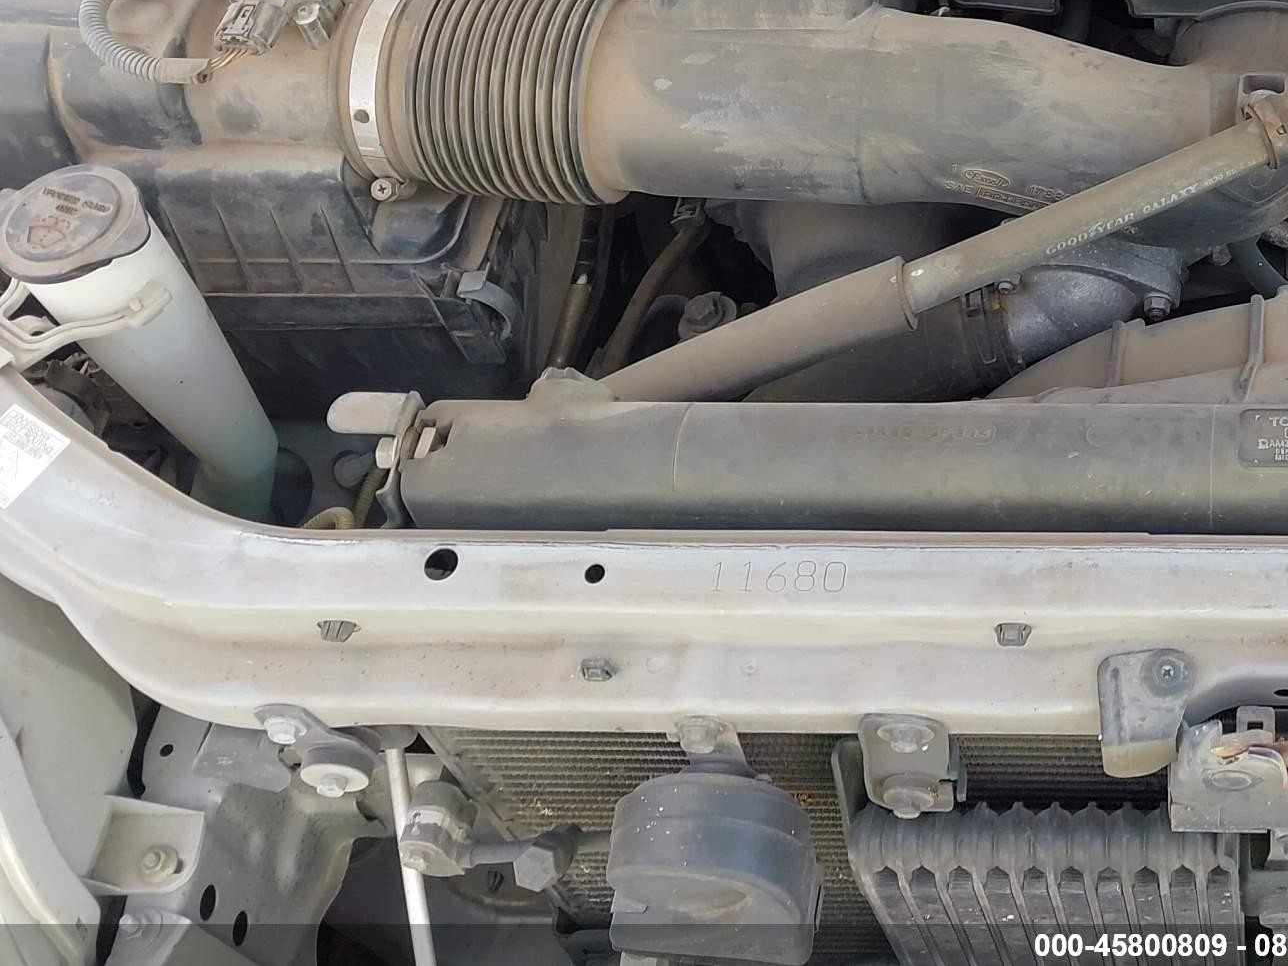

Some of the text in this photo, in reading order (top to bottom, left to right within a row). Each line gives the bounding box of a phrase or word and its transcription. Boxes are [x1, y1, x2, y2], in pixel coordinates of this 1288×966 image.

[1045, 183, 1199, 256] GOODYEAR GALAXY
[712, 560, 847, 593] 11680
